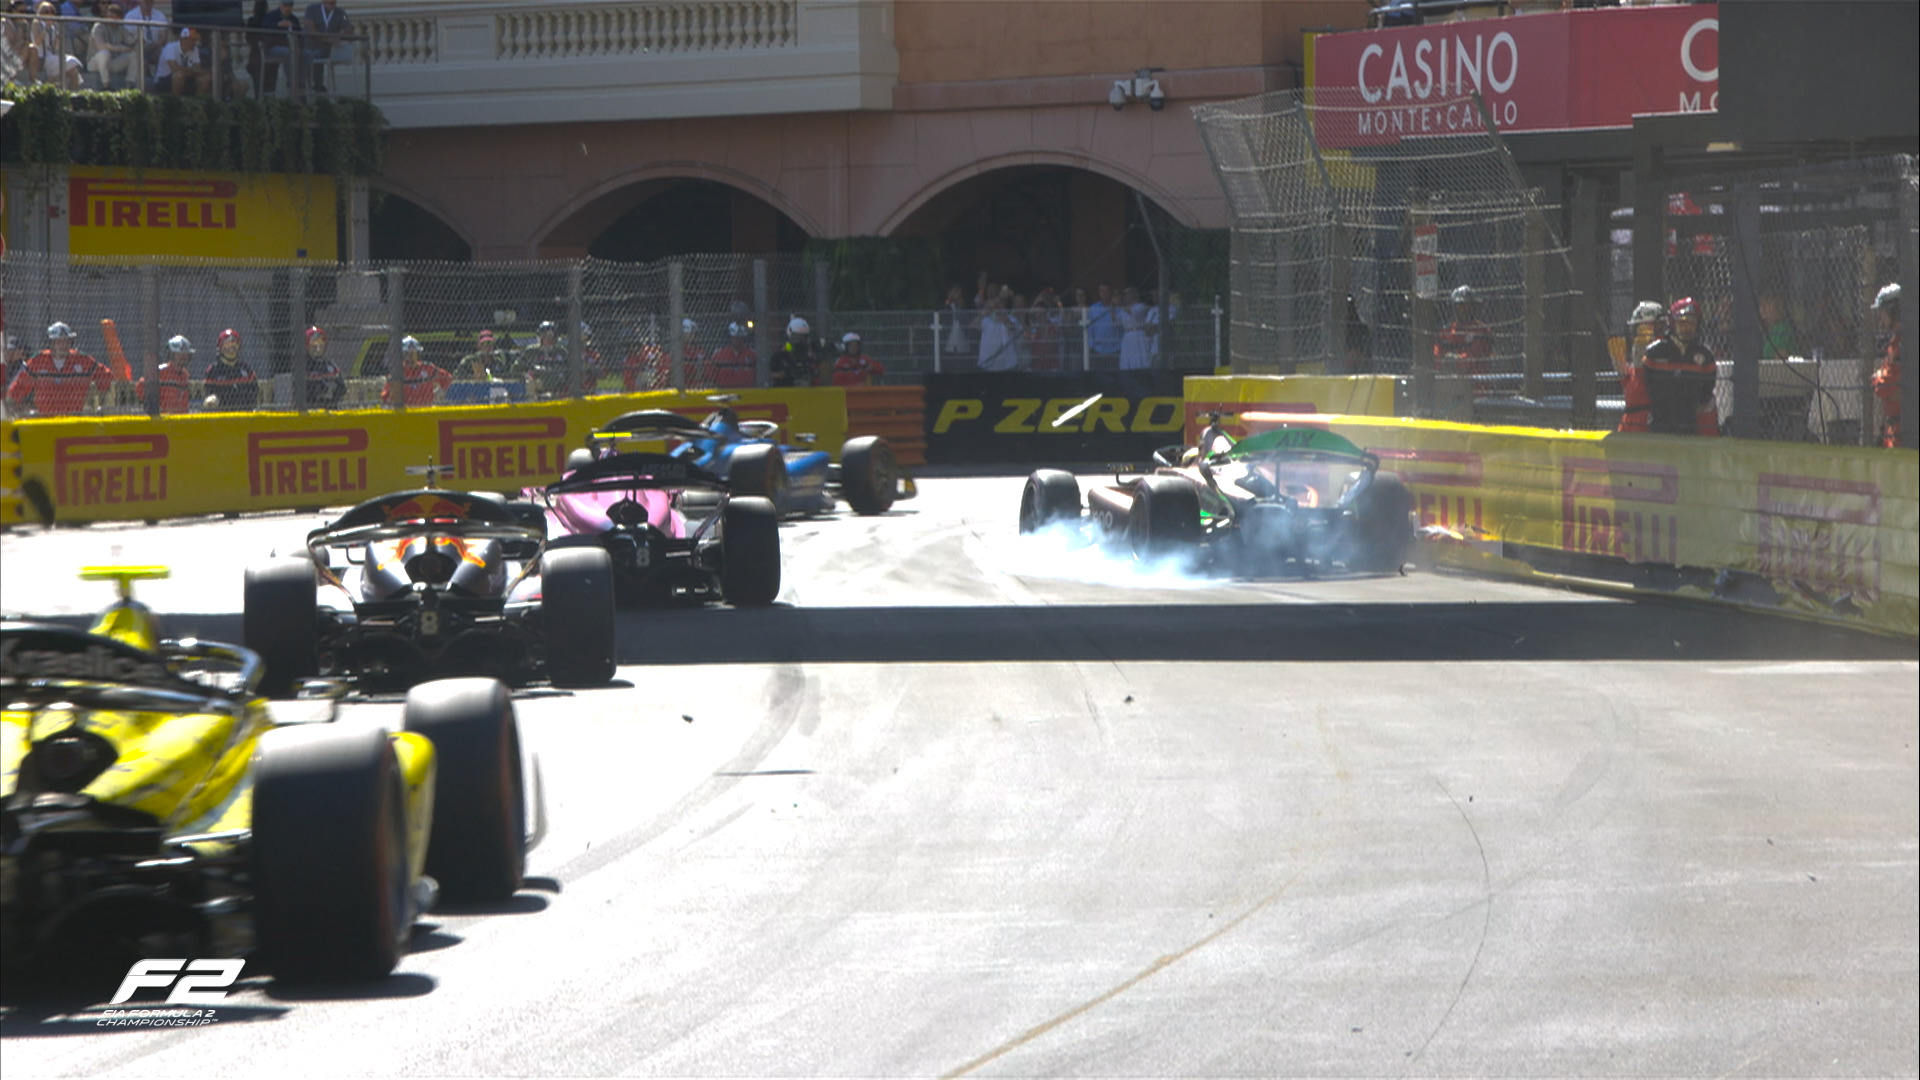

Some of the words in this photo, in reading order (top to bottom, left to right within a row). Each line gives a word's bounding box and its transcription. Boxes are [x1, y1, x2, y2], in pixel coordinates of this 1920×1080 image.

[1358, 31, 1518, 104] CASINO
[1358, 108, 1432, 134] MONTE
[69, 177, 238, 228] PIRELLI
[932, 398, 984, 433] P
[993, 396, 1185, 433] ZERO
[54, 433, 169, 507] PIRELLI
[247, 428, 369, 497] PIRELLI
[439, 416, 567, 480] PIRELLI
[1561, 456, 1680, 564] PIRELLI
